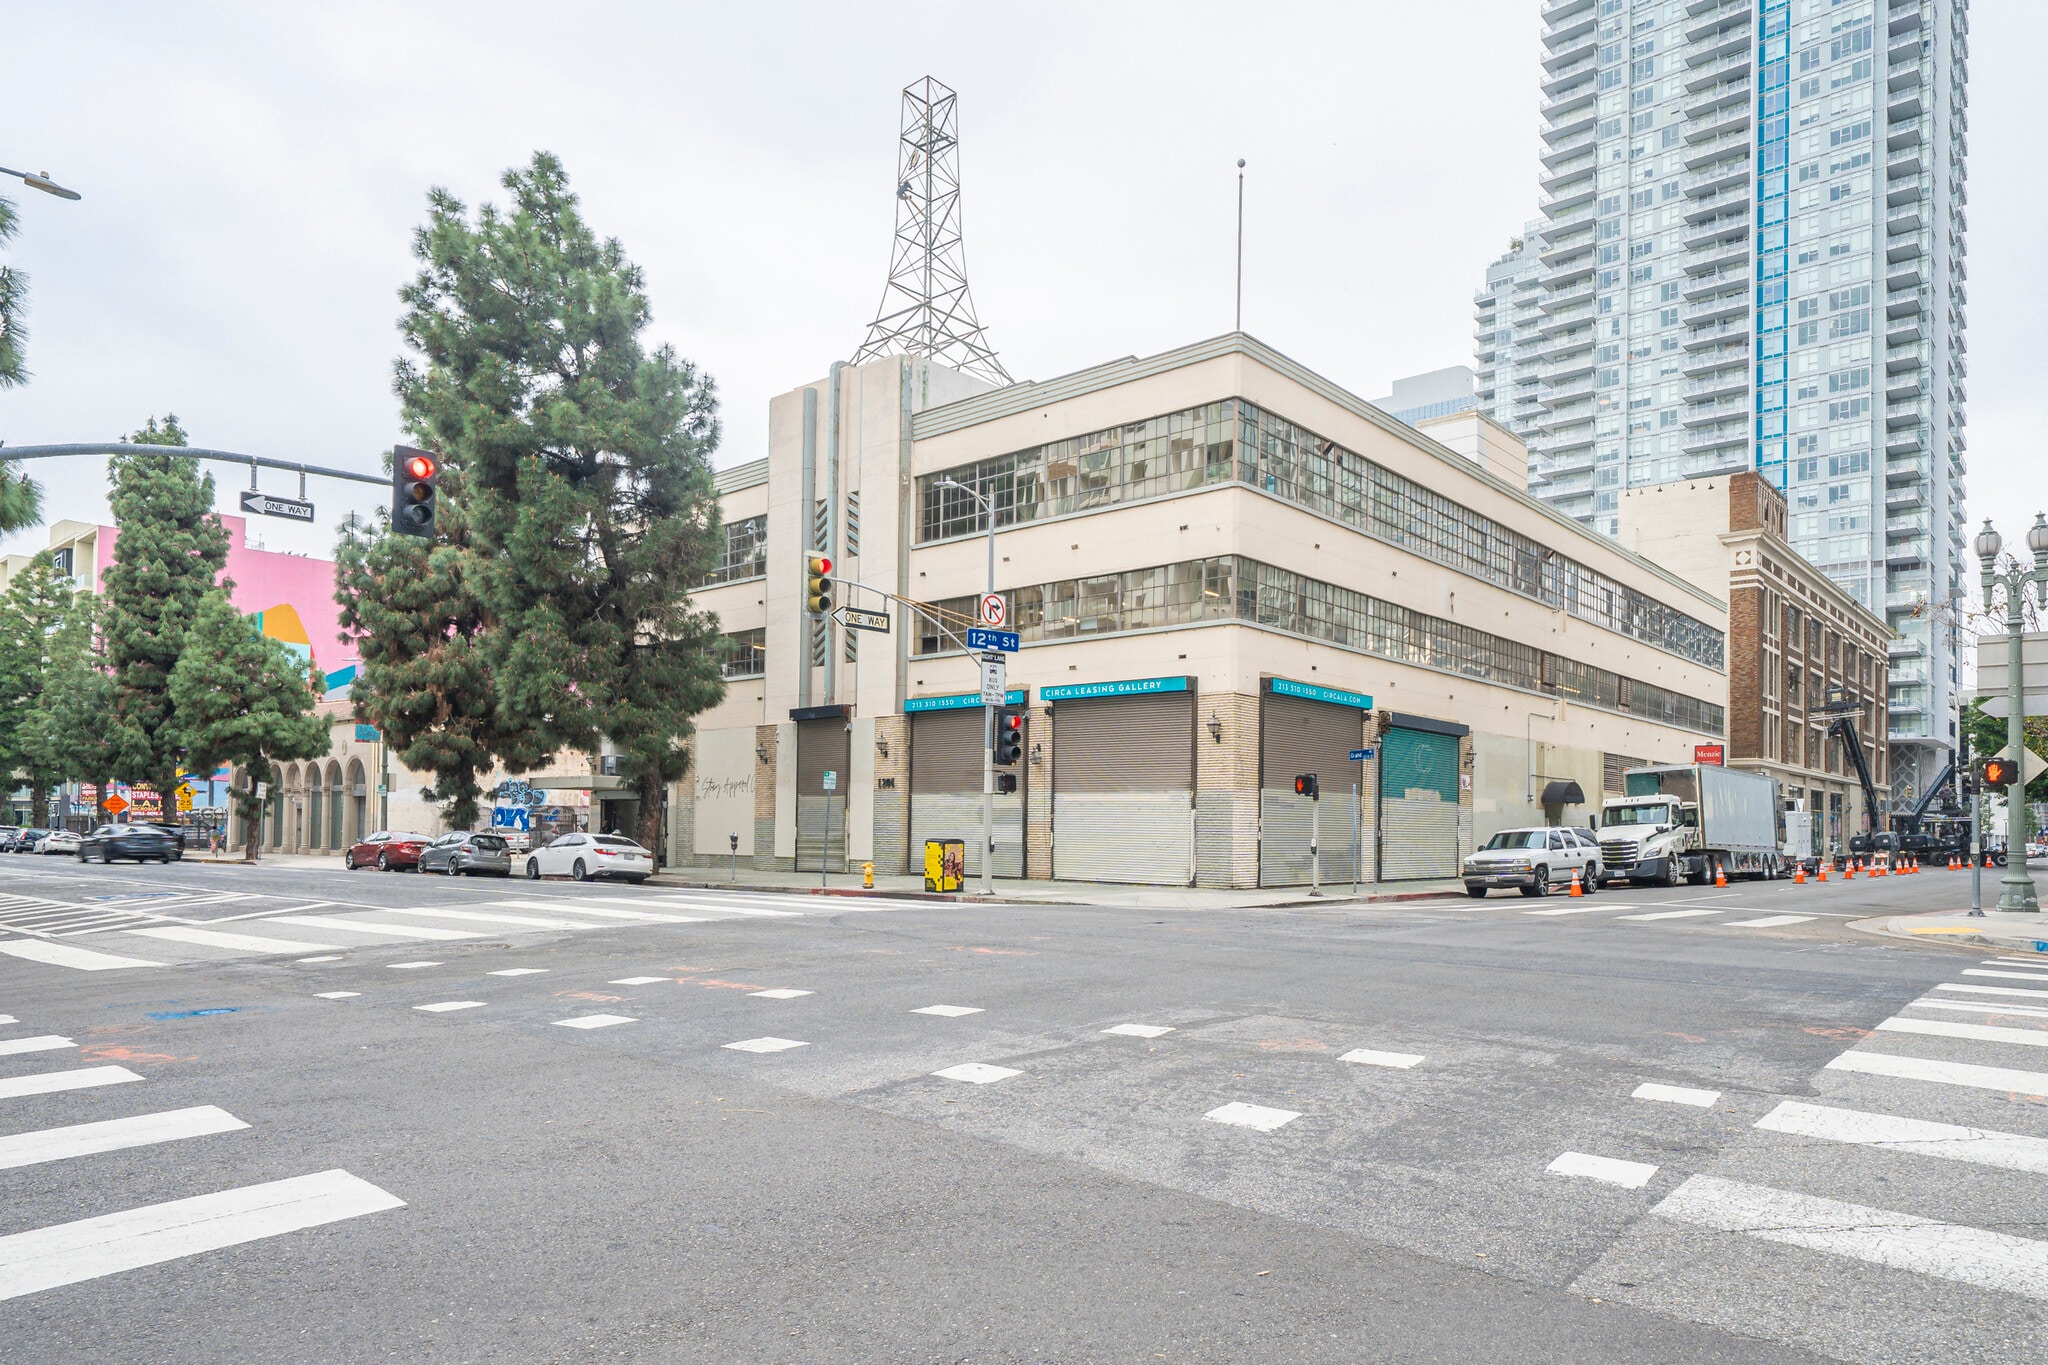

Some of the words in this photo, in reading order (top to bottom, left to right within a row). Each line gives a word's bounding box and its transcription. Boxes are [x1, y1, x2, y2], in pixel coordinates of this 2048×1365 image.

[265, 501, 284, 512] ONE
[287, 505, 308, 516] WAY
[845, 612, 862, 624] ONE
[868, 615, 886, 627] WAY
[972, 632, 997, 646] 12th
[1002, 636, 1015, 648] St
[1045, 689, 1072, 697] CIRCA
[1075, 684, 1115, 696] LEASING
[1118, 681, 1162, 692] GALLERY
[1278, 682, 1289, 691] 213
[1290, 685, 1301, 693] 310
[1302, 687, 1317, 696] 1550
[925, 700, 936, 708] 310
[938, 699, 954, 707] 1550
